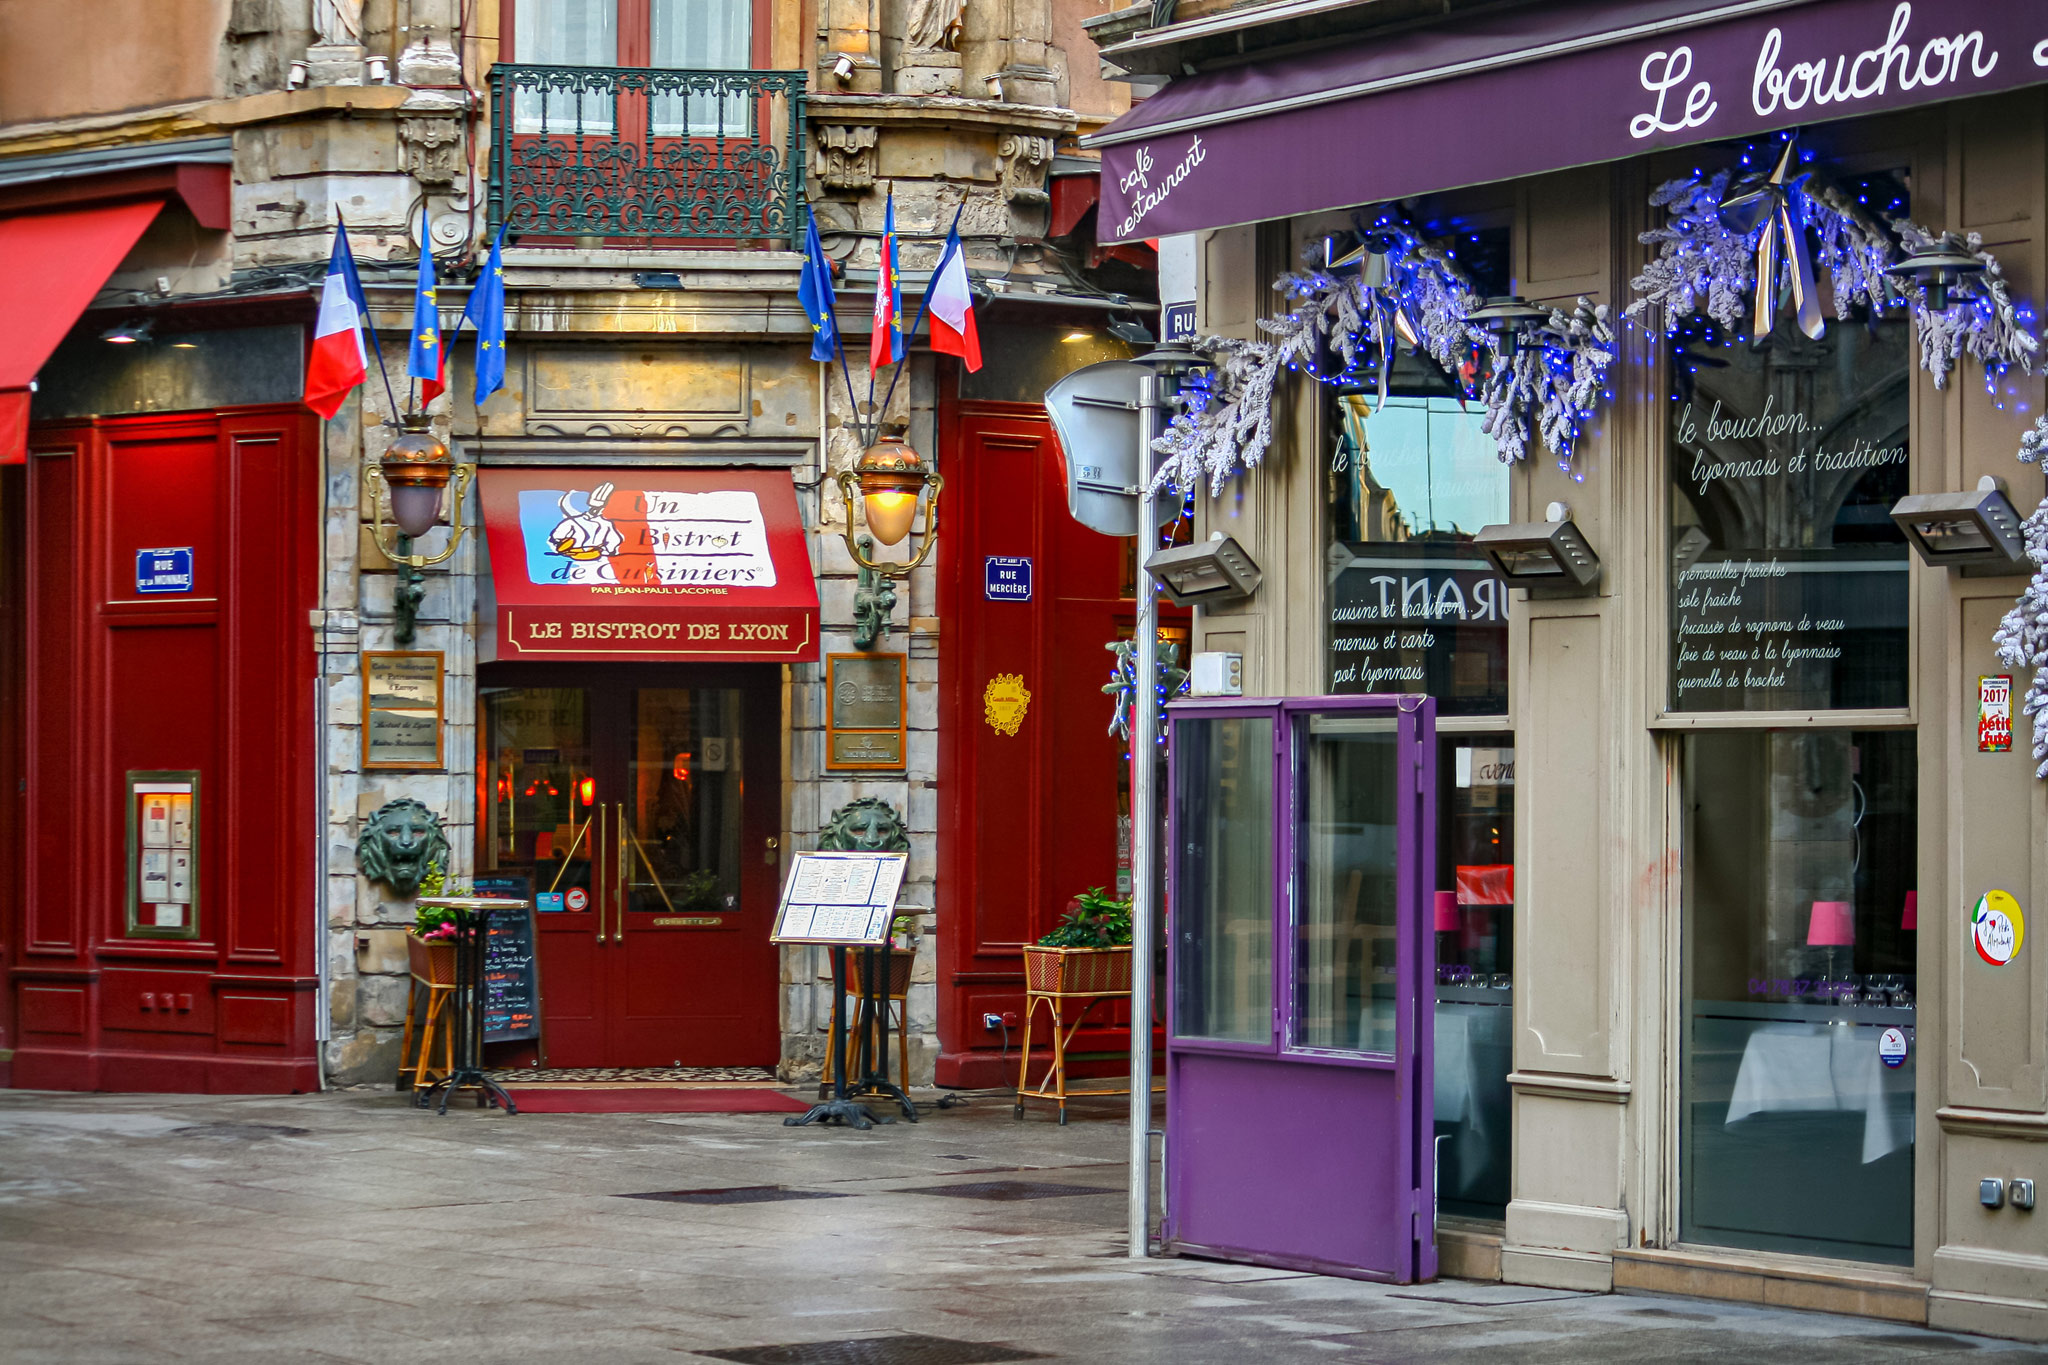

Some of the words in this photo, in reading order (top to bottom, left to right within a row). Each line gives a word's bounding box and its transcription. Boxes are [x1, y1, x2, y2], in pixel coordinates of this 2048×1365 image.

[1629, 45, 1717, 139] Le
[1752, 2, 1998, 116] bouchon
[1120, 146, 1154, 194] café
[1116, 135, 1206, 237] restaurant
[1678, 402, 1697, 444] le
[1332, 434, 1349, 473] le
[1691, 448, 1781, 496] lyonnais
[1788, 447, 1807, 474] et
[1815, 438, 1908, 472] tradition
[634, 495, 680, 514] Un
[639, 526, 742, 552] Bistrot
[154, 560, 173, 571] RUE
[550, 560, 587, 581] de
[1000, 570, 1017, 580] RUE
[1678, 559, 1739, 589] grenouilles
[155, 574, 189, 585] MONNAIE
[990, 583, 1027, 594] MERCIÈRE
[614, 587, 672, 596] JEAN-PAUL
[674, 587, 728, 595] LACOMBE
[1678, 587, 1700, 609] sôle
[1332, 600, 1379, 621] cuisine
[1383, 598, 1397, 618] et
[529, 623, 562, 639] LE
[571, 623, 680, 640] BISTROT
[687, 624, 720, 640] DE
[728, 624, 789, 641] LYON
[1728, 615, 1741, 633] de
[1746, 621, 1794, 641] rognons
[1797, 613, 1811, 631] de
[1815, 618, 1845, 631] veau
[1333, 636, 1379, 651] menus
[1383, 629, 1397, 649] et
[1400, 628, 1435, 649] carte
[1677, 641, 1699, 670] foie
[1702, 643, 1715, 661] de
[1720, 649, 1748, 661] veau
[1751, 646, 1760, 660] à
[1764, 639, 1777, 660] la
[1781, 639, 1841, 667] lyonnaise
[1332, 662, 1356, 692] pot
[1361, 655, 1424, 692] lyonnais
[1726, 669, 1739, 687] de
[1743, 666, 1786, 688] brochet
[1984, 689, 2008, 703] 2017
[1978, 717, 2012, 735] petit
[1984, 731, 2012, 745] futé
